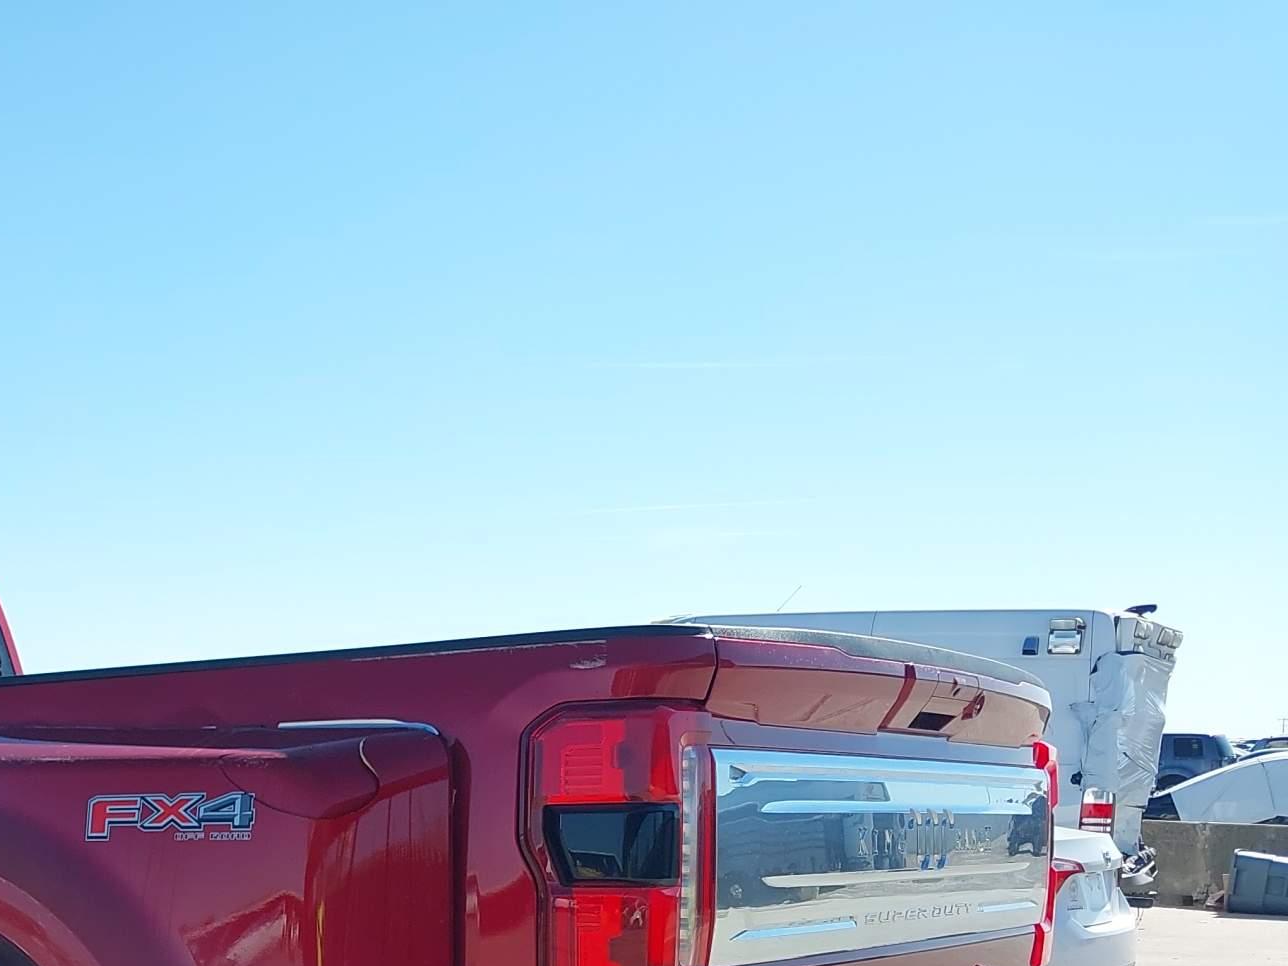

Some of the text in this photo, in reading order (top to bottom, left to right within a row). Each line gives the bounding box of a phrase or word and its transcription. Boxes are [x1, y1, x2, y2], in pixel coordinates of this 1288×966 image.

[85, 790, 256, 842] FX4
[173, 831, 252, 841] OFF ROAD
[864, 902, 972, 926] SUPER DUTY
